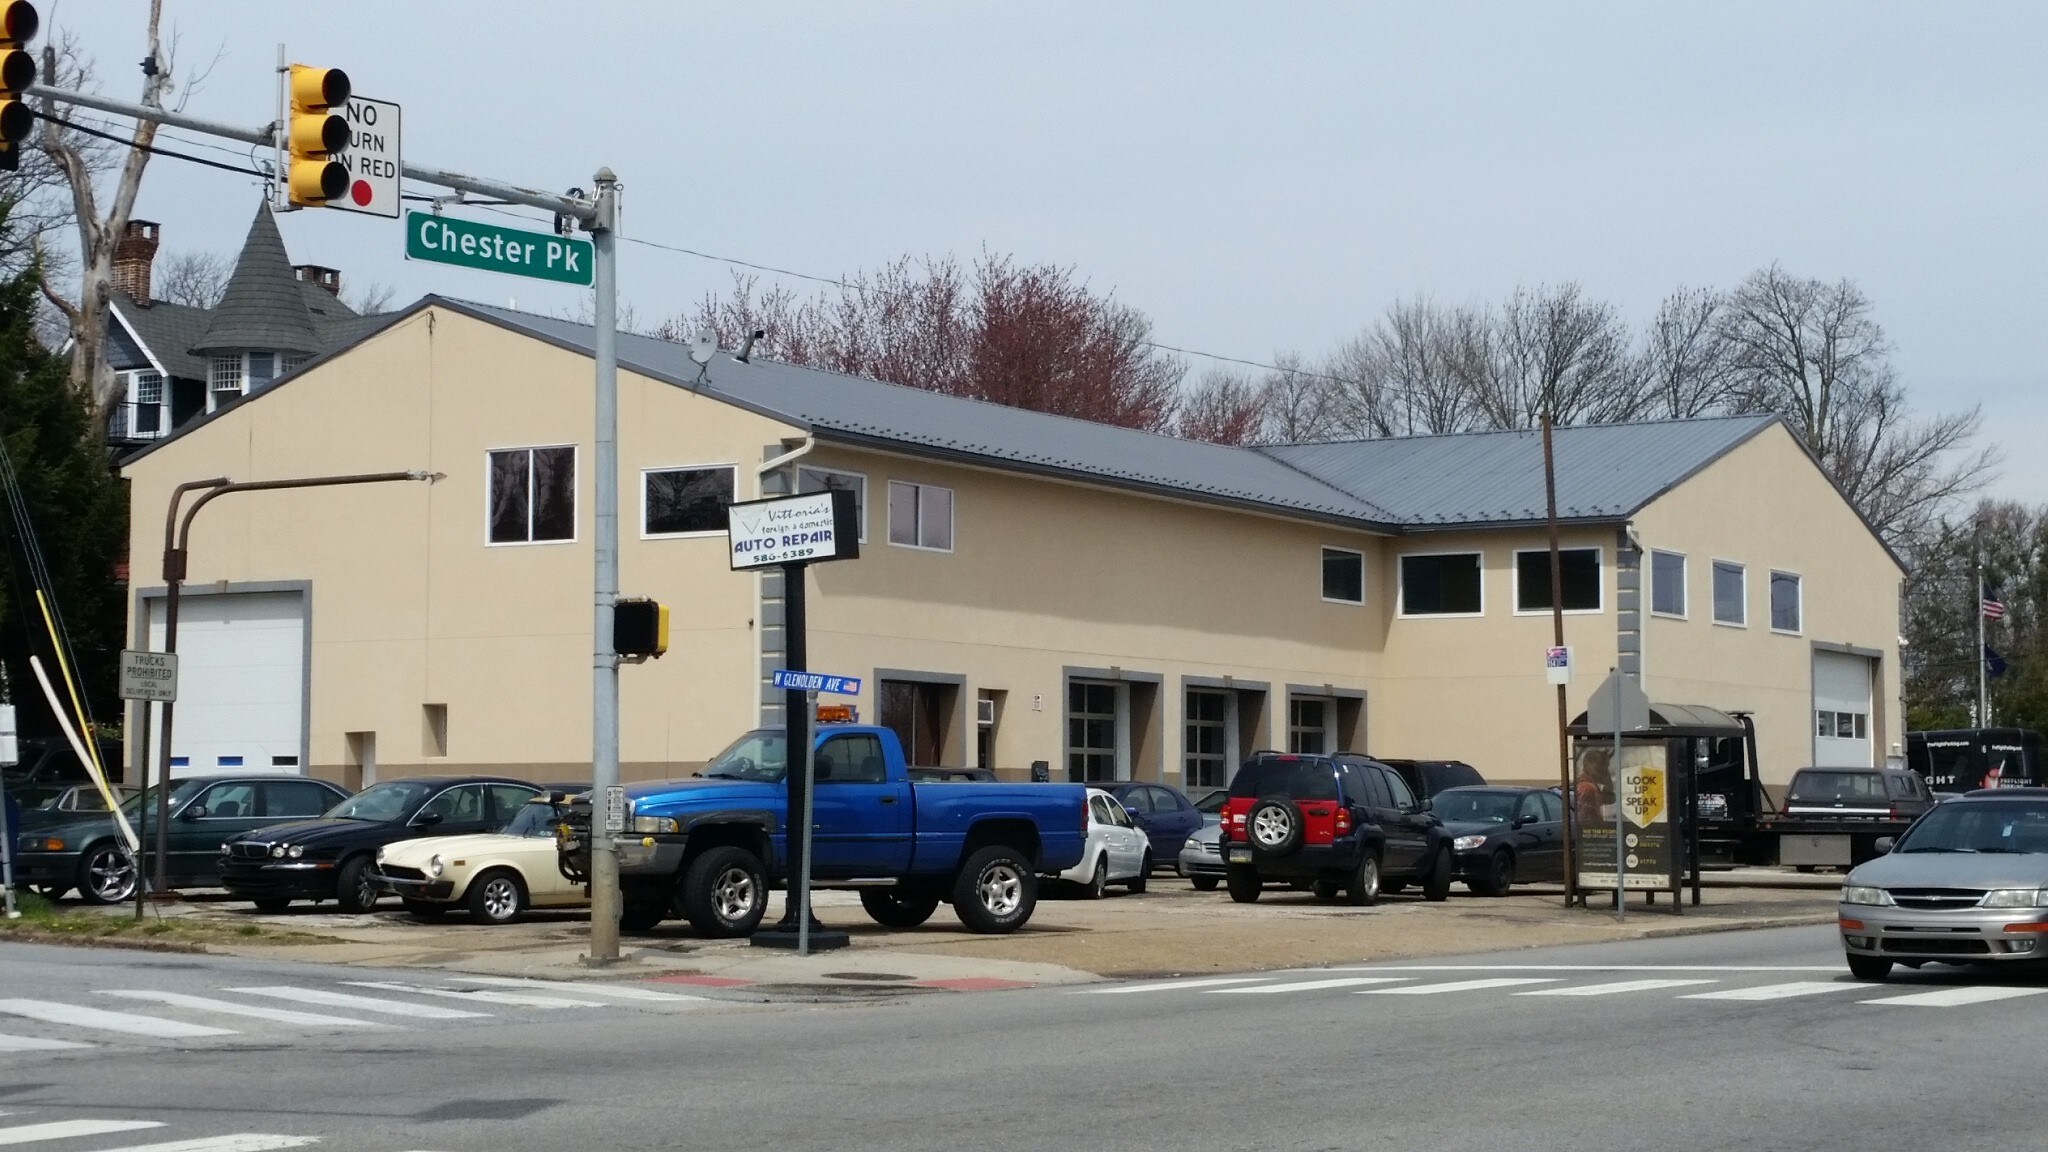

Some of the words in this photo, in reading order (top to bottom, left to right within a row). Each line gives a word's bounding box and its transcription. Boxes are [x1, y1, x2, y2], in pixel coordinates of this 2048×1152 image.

[346, 103, 377, 126] NO
[348, 129, 385, 153] URN
[360, 156, 395, 180] RED
[420, 220, 536, 265] Chester
[546, 241, 580, 273] Pk
[768, 503, 831, 522] Vittoria's
[762, 524, 790, 535] foreign
[800, 518, 833, 530] domestic
[734, 537, 776, 554] AUTO
[782, 530, 833, 547] REPAIR
[753, 548, 814, 563] 586-6389
[134, 655, 165, 667] TRUCKS
[127, 666, 172, 679] PROHIBITED
[140, 681, 158, 689] LOCAL
[774, 672, 782, 686] W
[783, 673, 824, 689] GLENOLDEN
[825, 678, 842, 692] AVE
[1626, 776, 1657, 785] LOOK
[1626, 797, 1658, 806] SPEAK
